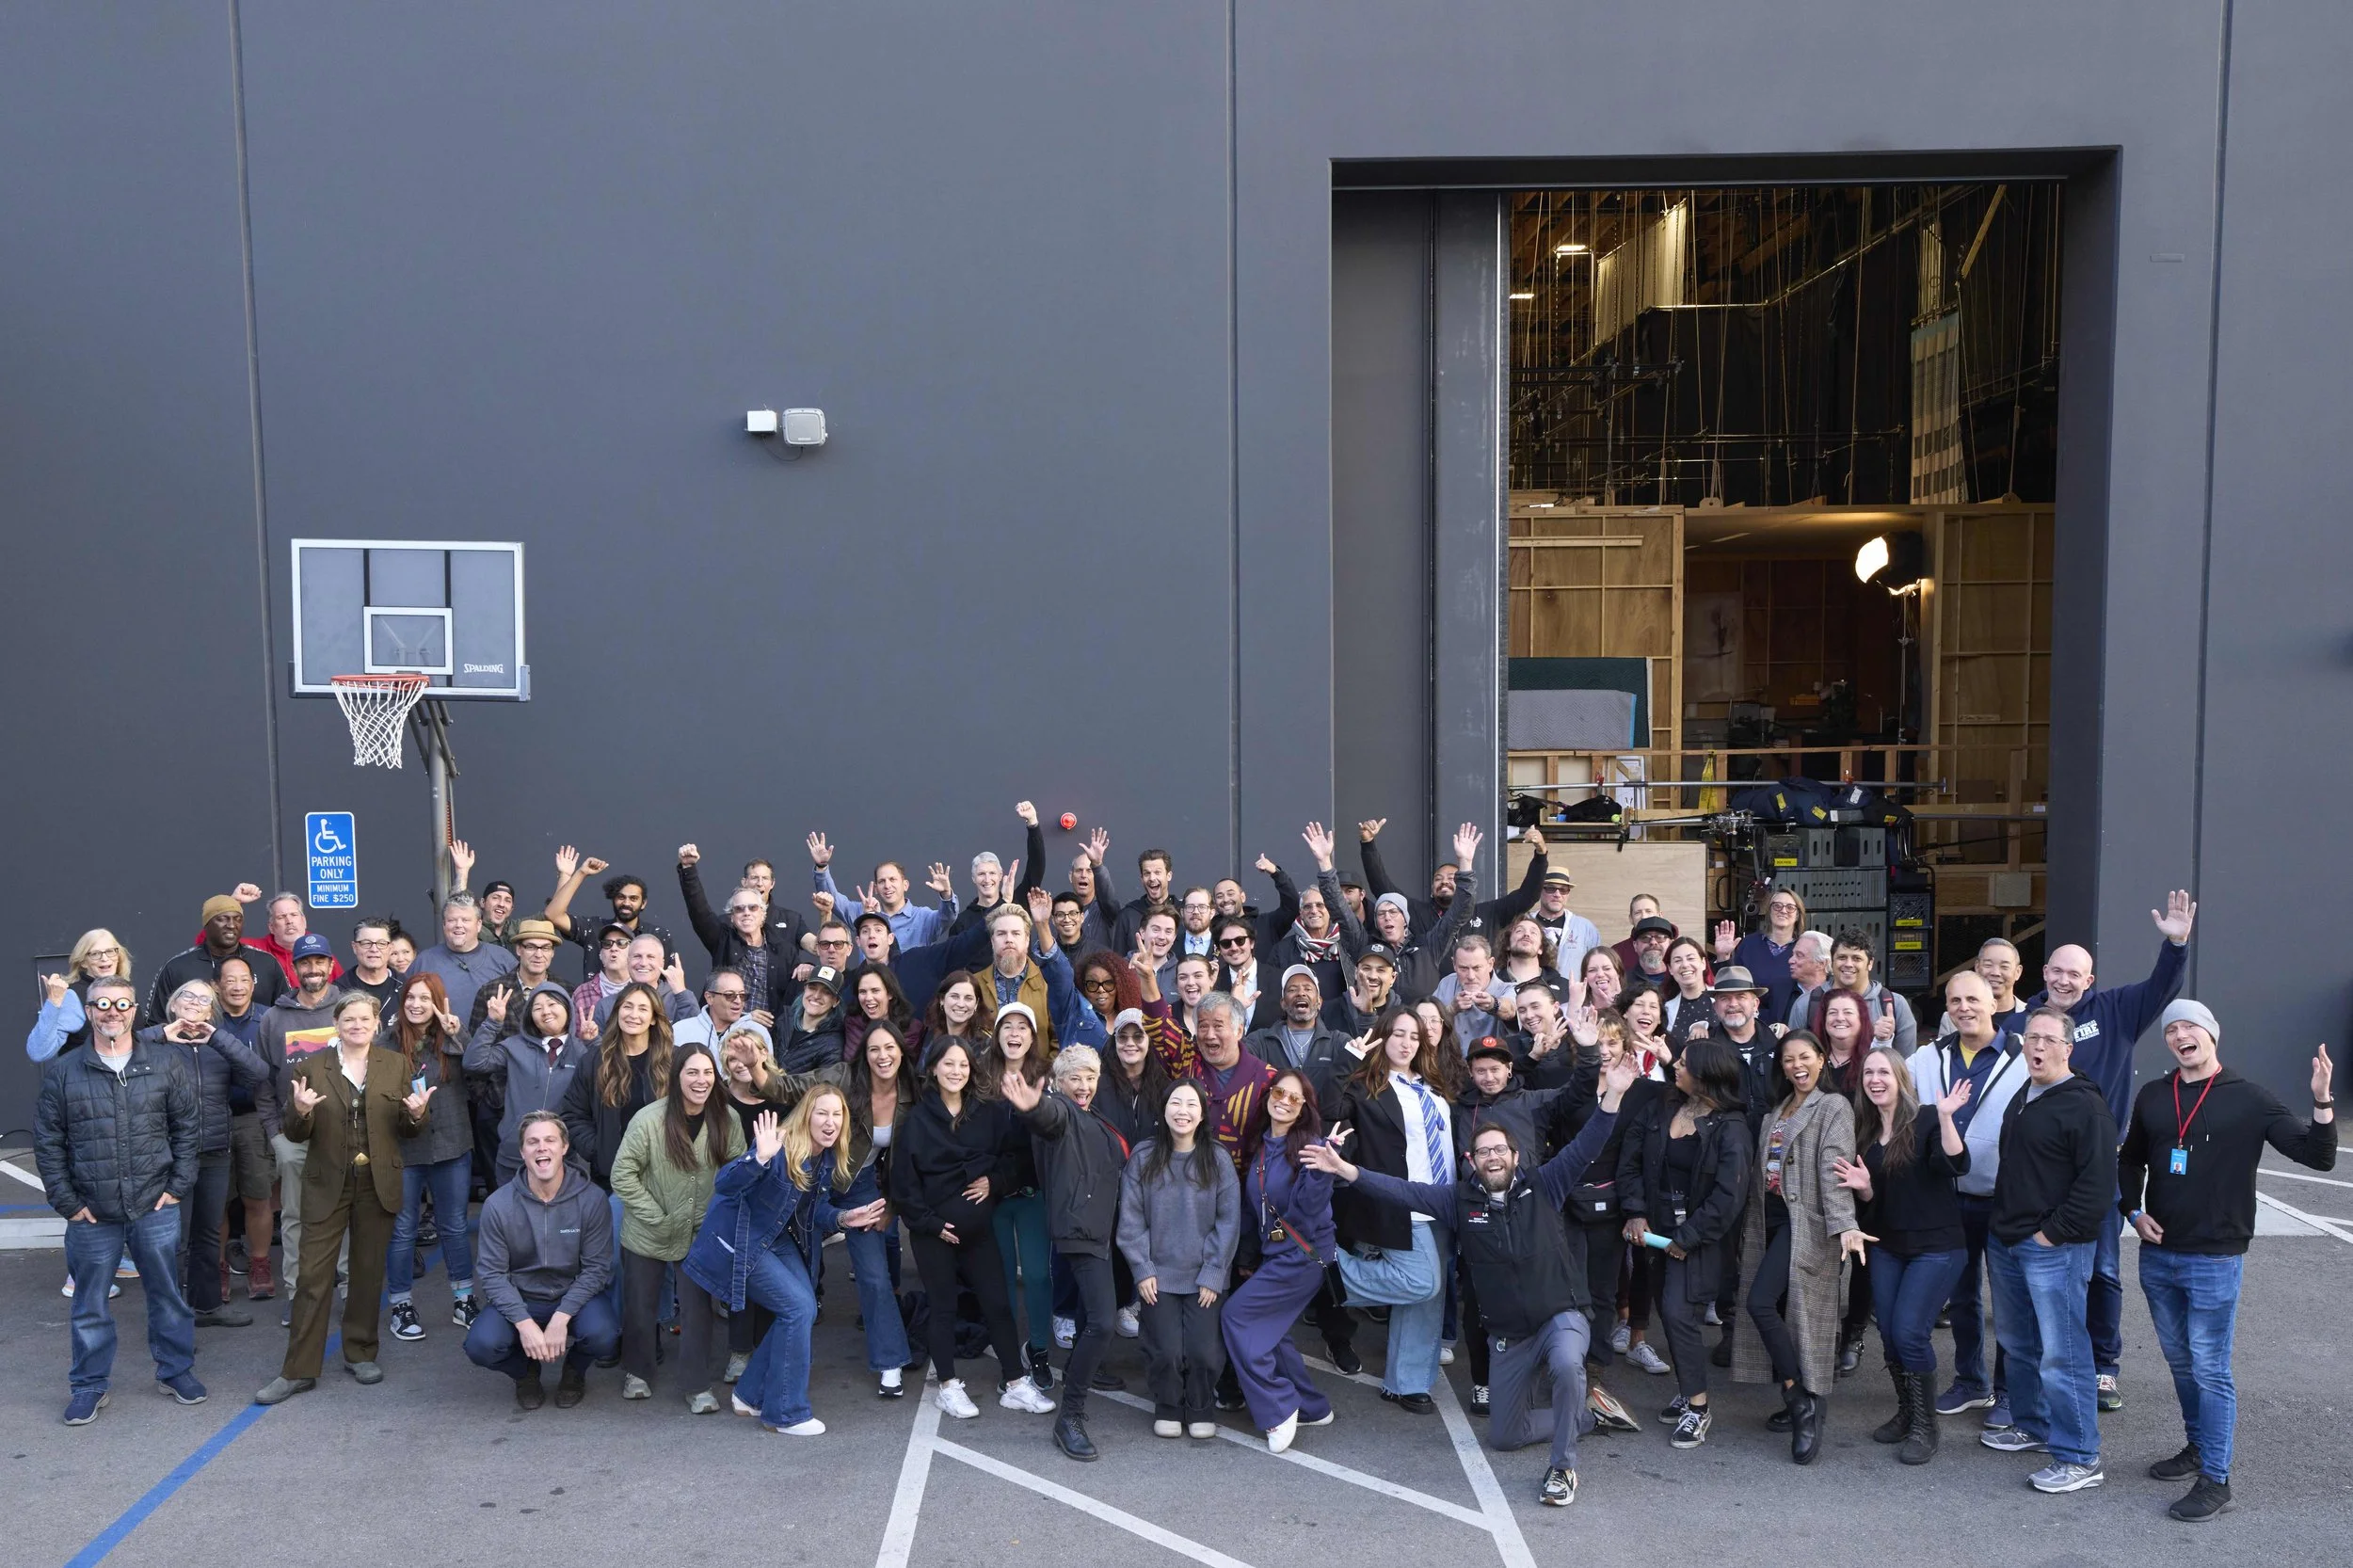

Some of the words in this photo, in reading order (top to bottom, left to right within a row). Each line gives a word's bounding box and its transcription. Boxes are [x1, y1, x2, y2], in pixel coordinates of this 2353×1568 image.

[463, 663, 504, 674] SPALDING
[312, 856, 352, 867] PARKING
[320, 868, 344, 879] ONLY
[316, 884, 349, 893] MINIMUM
[312, 894, 329, 903] FINE
[332, 893, 354, 904] $250
[2073, 1023, 2100, 1039] FIRE
